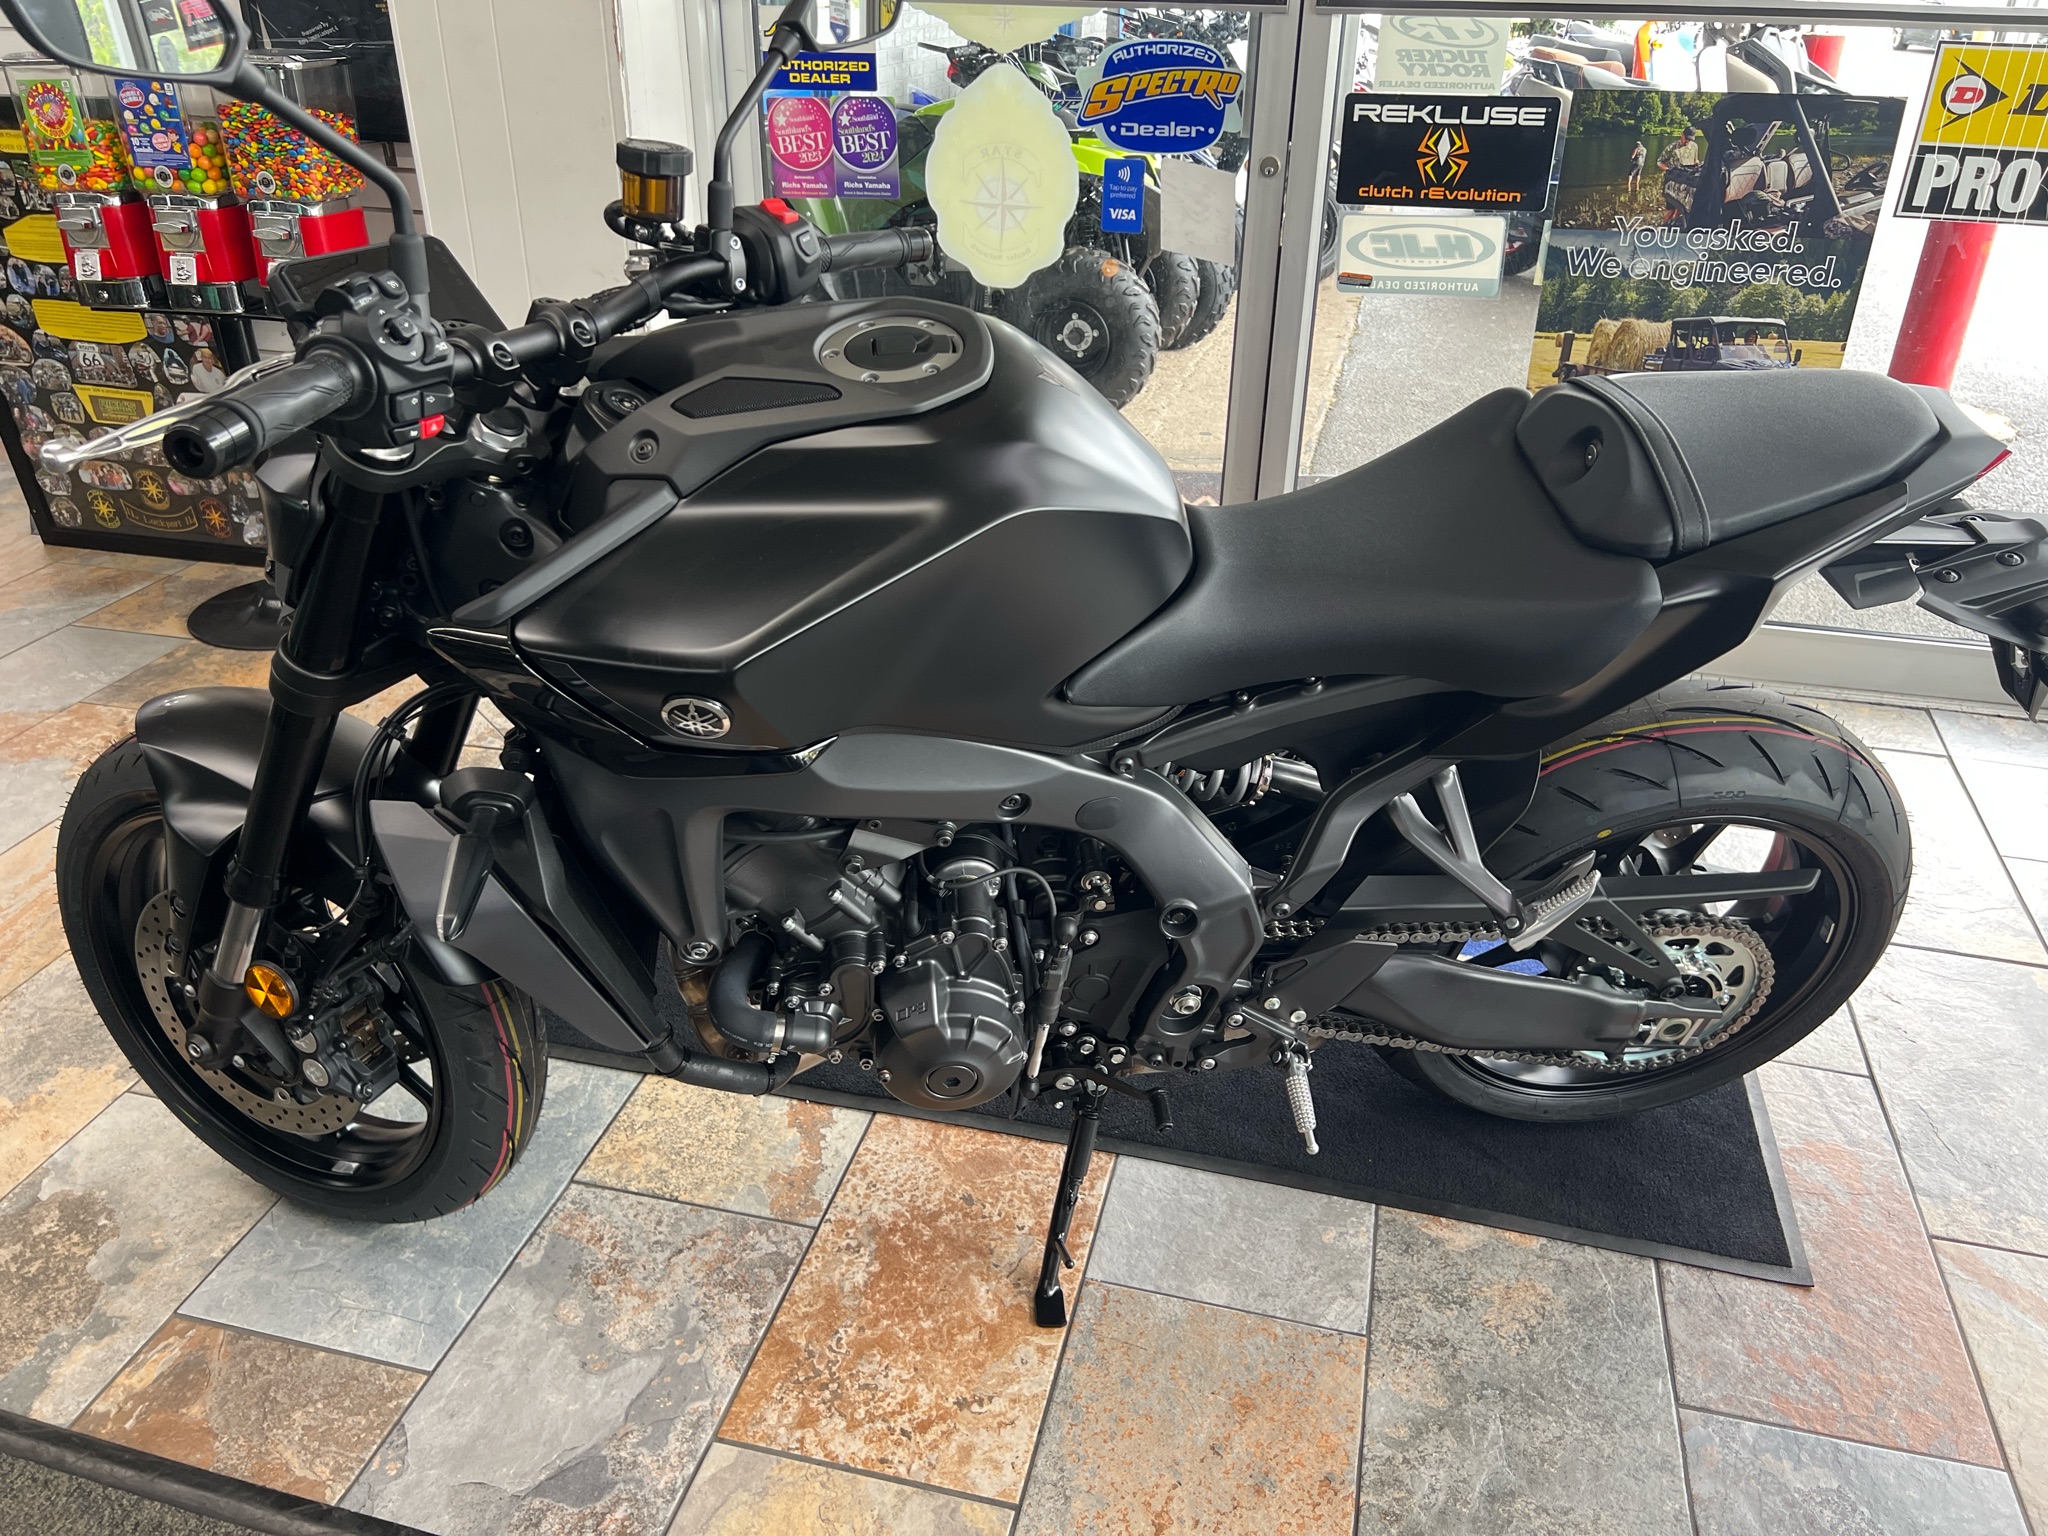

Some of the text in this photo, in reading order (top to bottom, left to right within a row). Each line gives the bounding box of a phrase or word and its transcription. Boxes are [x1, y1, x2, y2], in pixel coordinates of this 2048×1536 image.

[1112, 44, 1217, 64] AUTHORIZED
[779, 60, 870, 72] UTHORIZED
[789, 73, 851, 84] DEALER
[1084, 70, 1242, 117] SPECTRO
[1352, 103, 1547, 126] REKLUSE
[1120, 121, 1205, 137] Dealer
[777, 131, 827, 155] BEST
[840, 131, 891, 155] BEST
[799, 151, 822, 163] 2023
[861, 151, 885, 163] 2024
[864, 181, 891, 189] Yamaha
[1109, 184, 1119, 192] Tap
[1912, 154, 2048, 213] PRO
[1358, 185, 1521, 202] clutch rEvolution
[1108, 208, 1136, 221] VISA
[1615, 215, 1805, 254] You asked.
[1566, 247, 1842, 290] We engineered.
[82, 352, 102, 367] 66
[143, 514, 182, 529] Lockport
